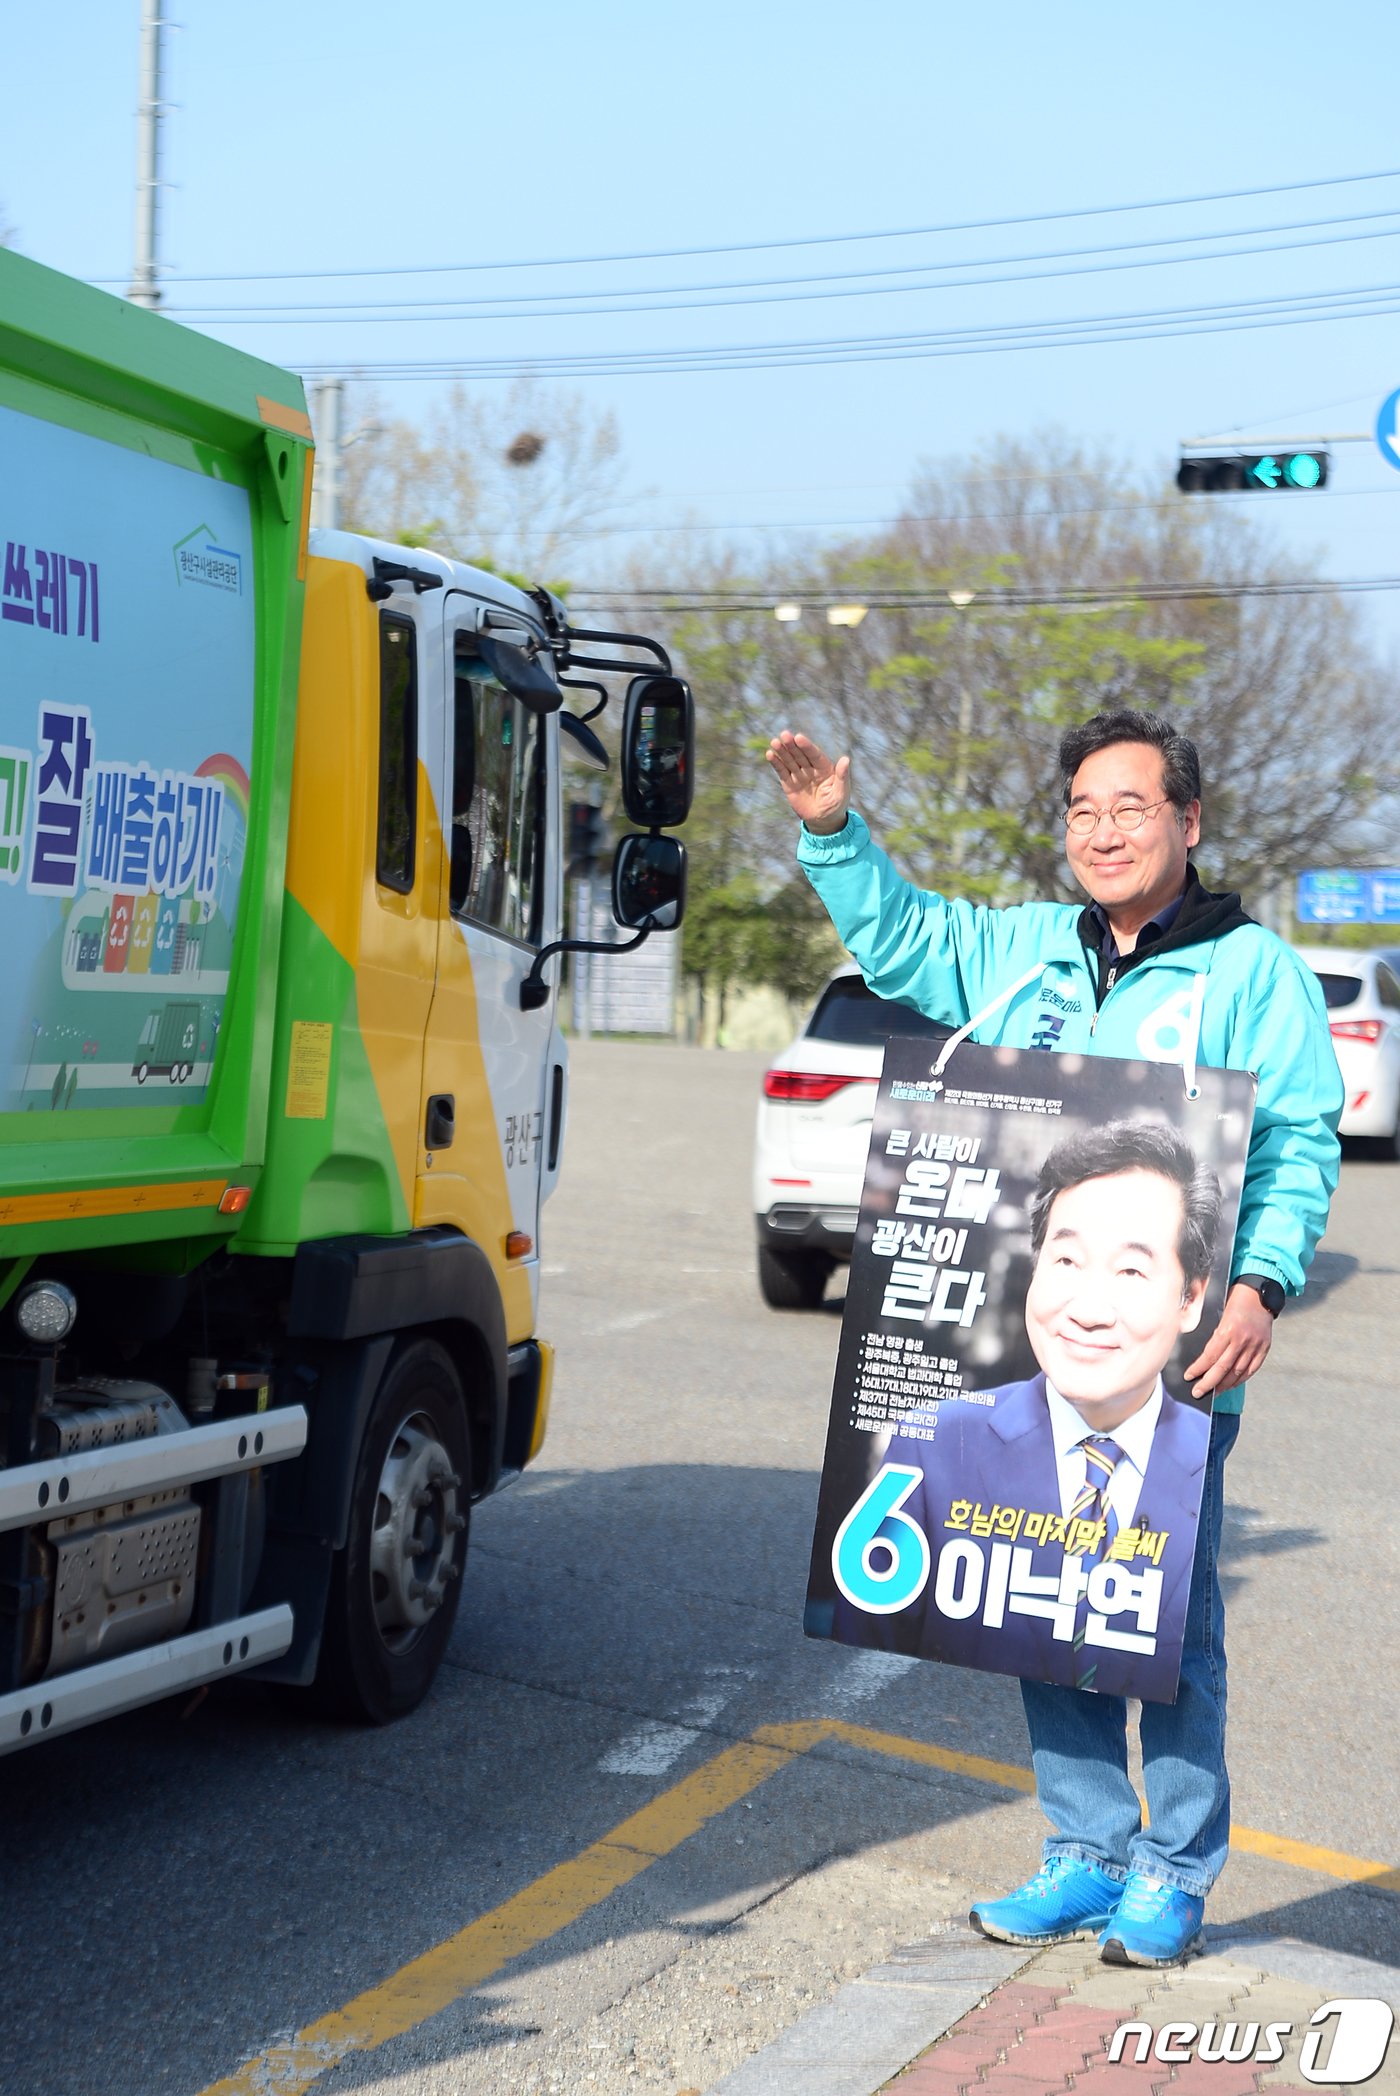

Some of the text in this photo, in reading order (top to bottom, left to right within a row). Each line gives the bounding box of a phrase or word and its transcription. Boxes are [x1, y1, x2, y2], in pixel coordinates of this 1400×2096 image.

[2, 541, 99, 643] 쓰레기
[31, 712, 91, 887] 잘
[88, 772, 221, 892] 배출하기!
[889, 1087, 936, 1103] 새로운미래
[504, 1113, 543, 1168] 광산구
[885, 1129, 981, 1164] 큰 사람이
[895, 1159, 1001, 1225] 온다
[871, 1219, 969, 1265] 광산이
[880, 1260, 987, 1328] 큰다
[867, 1333, 924, 1352] 전남 영광 출생
[862, 1361, 962, 1387] 서울대학교 법과대학 졸업
[903, 1352, 938, 1368] 광주일고
[939, 1357, 958, 1372] 졸업
[857, 1404, 938, 1427] 제45대 국무총리(전)
[859, 1390, 940, 1413] 제37대 전남지사(전)
[960, 1390, 995, 1407] 국회의원
[855, 1418, 935, 1441] 새로운미래 공동대표
[943, 1498, 1170, 1566] 호남의 마지막 불씨
[831, 1462, 1165, 1657] 6 이낙연
